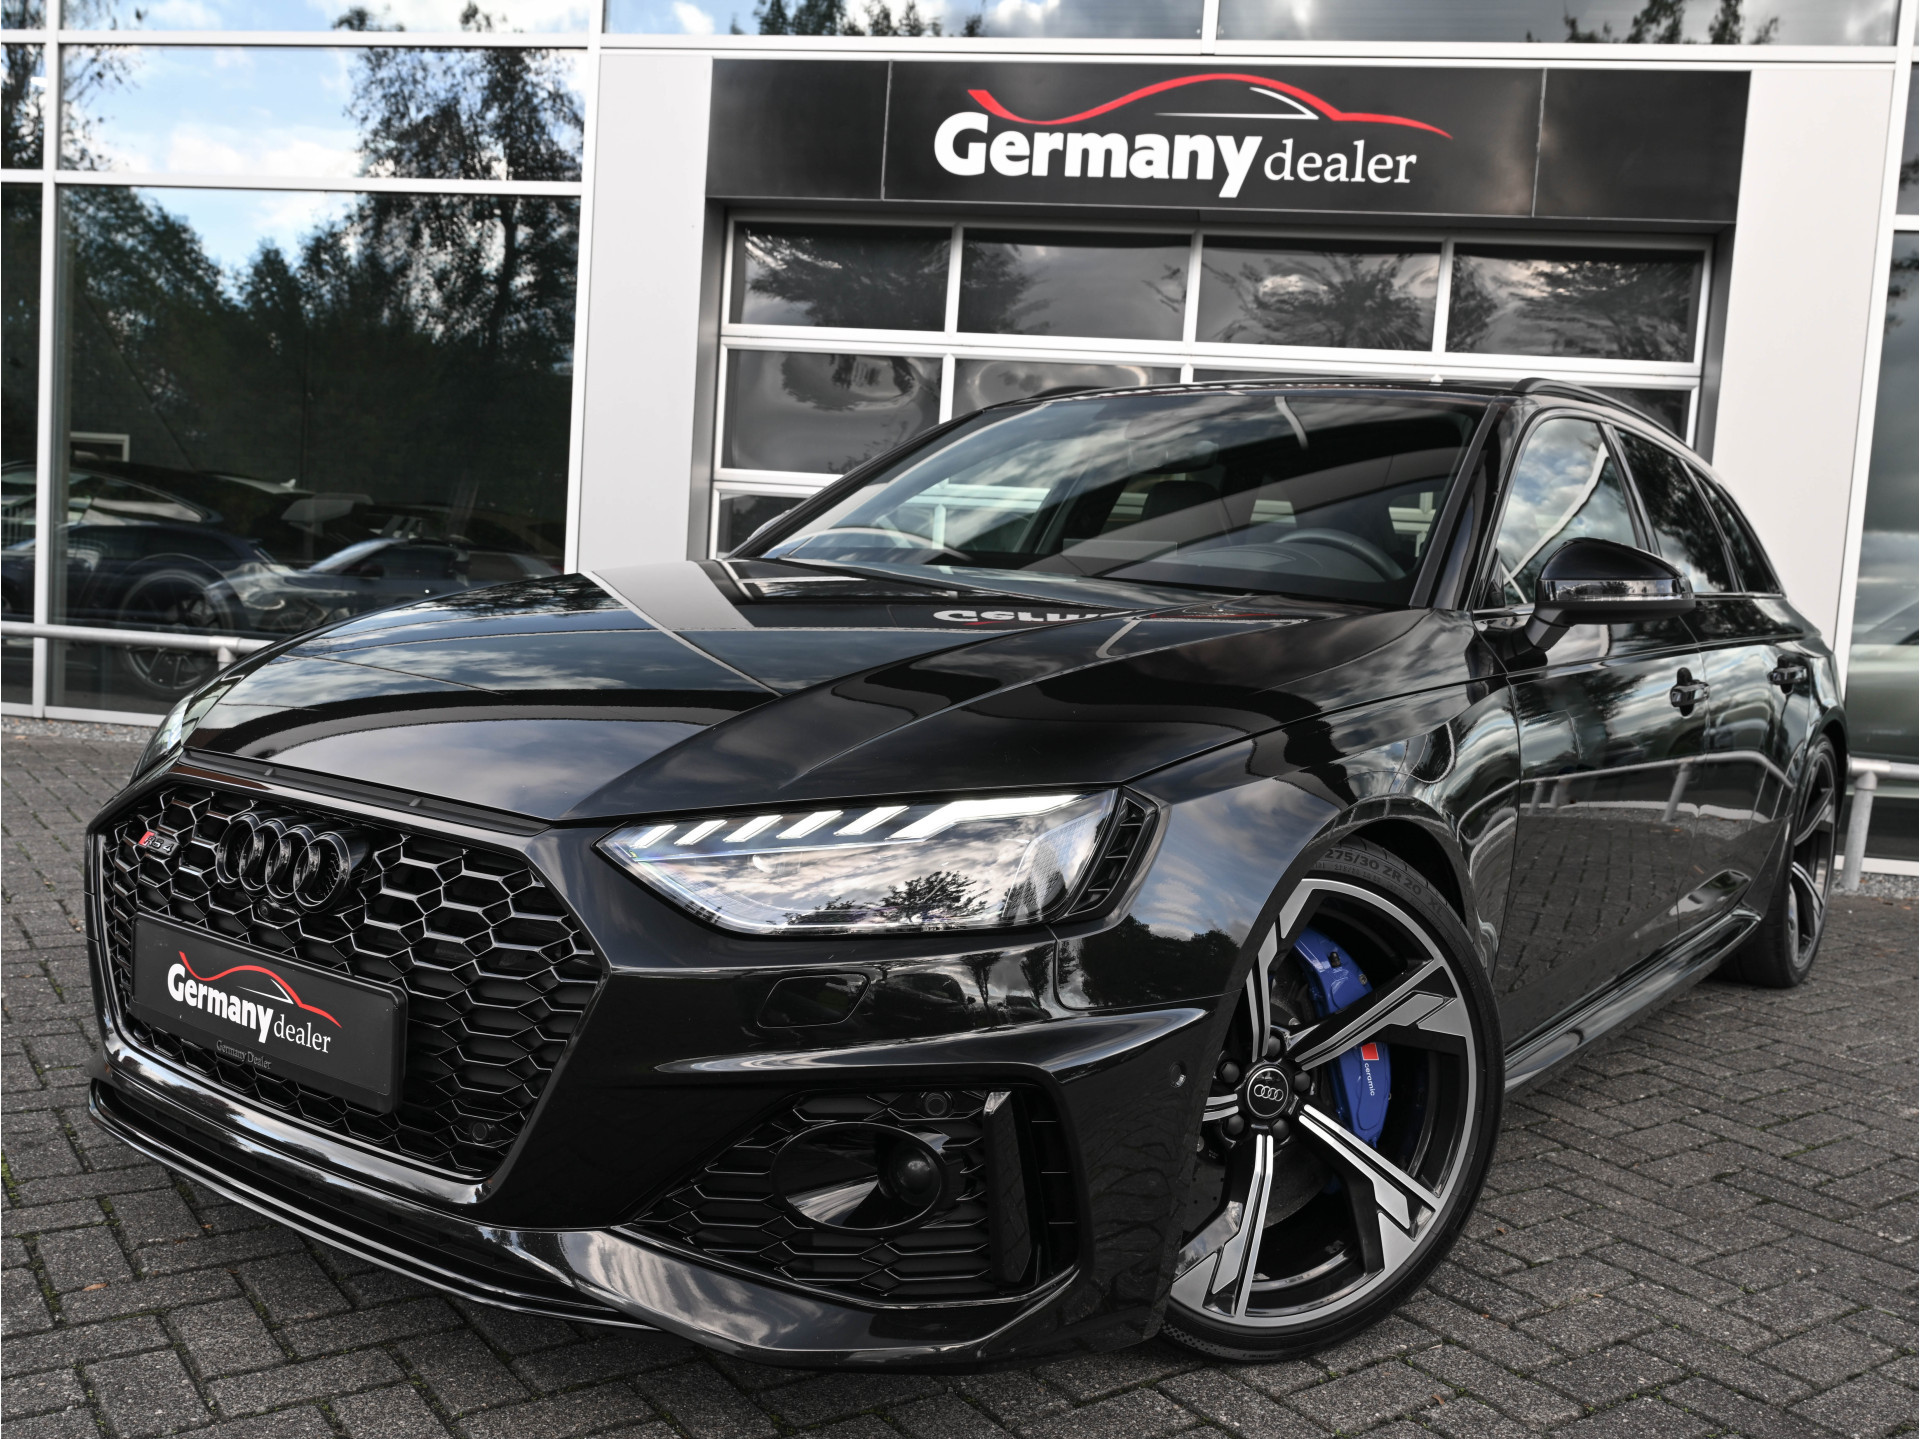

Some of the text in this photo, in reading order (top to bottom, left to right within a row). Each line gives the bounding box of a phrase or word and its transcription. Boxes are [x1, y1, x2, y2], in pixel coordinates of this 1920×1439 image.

[934, 111, 1417, 198] Germany dealer
[1381, 867, 1401, 883] ZR
[1403, 876, 1422, 895] 20
[167, 963, 331, 1054] Germany dealer
[216, 1039, 272, 1070] Germany Dealer
[1364, 1062, 1376, 1097] ceramic
